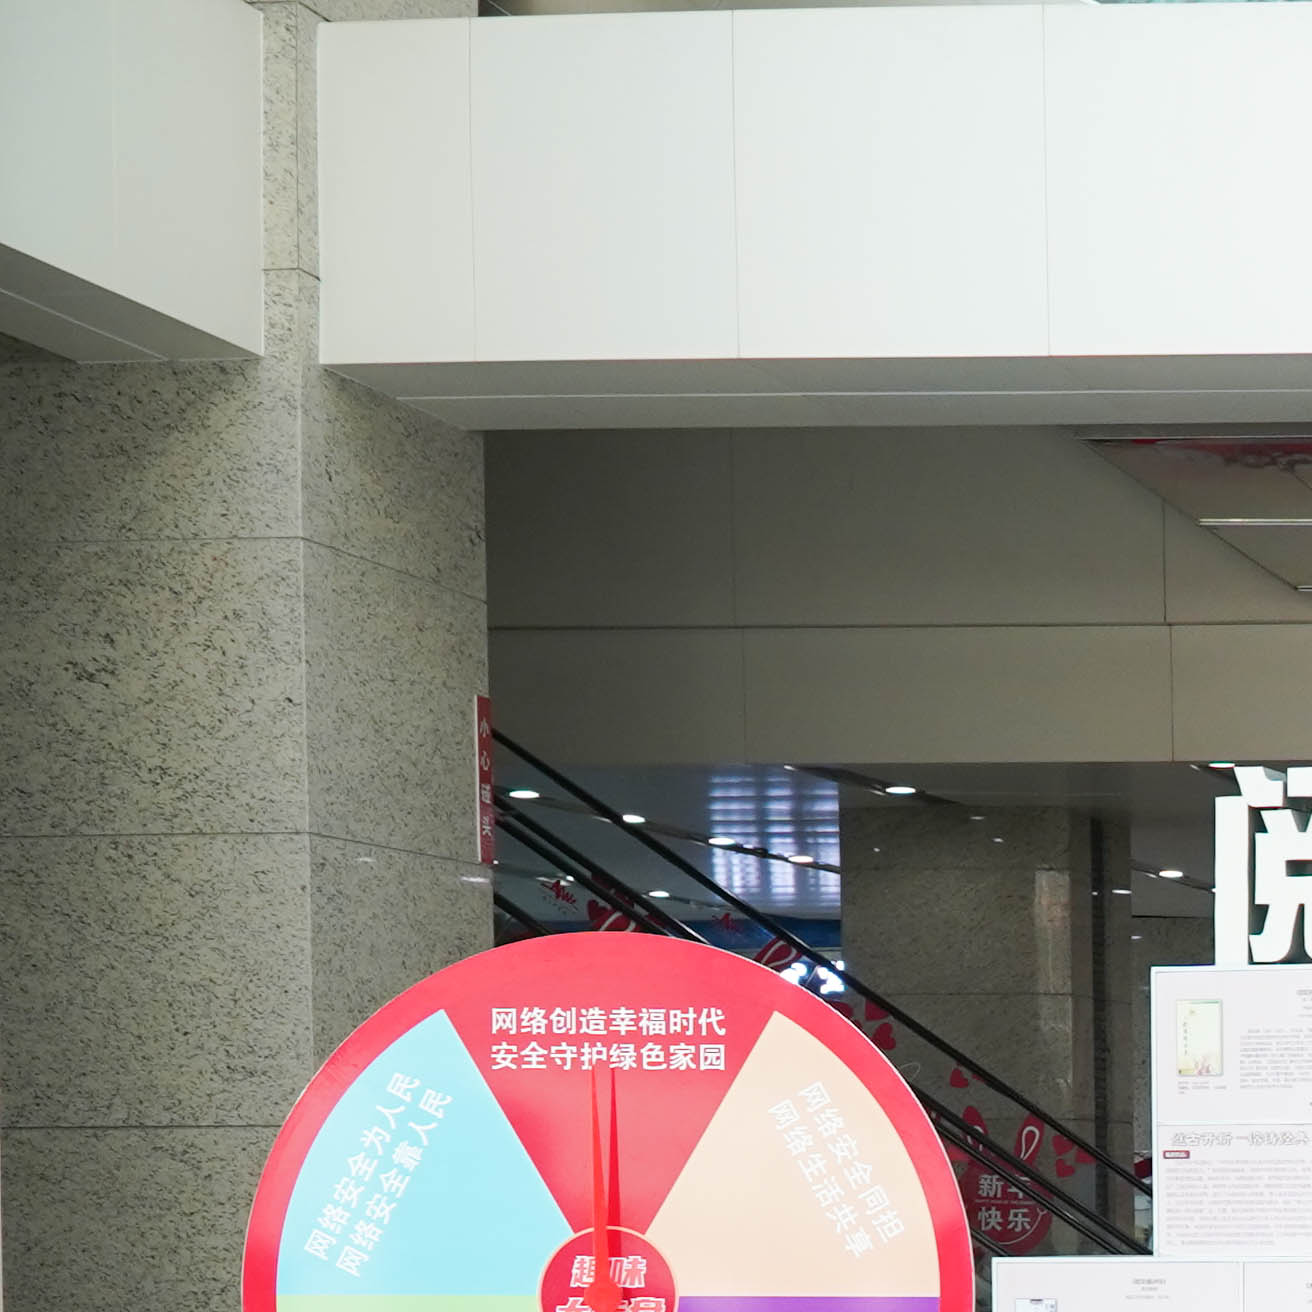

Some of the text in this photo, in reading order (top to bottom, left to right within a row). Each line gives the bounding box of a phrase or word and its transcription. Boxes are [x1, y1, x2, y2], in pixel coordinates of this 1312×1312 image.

[490, 1006, 727, 1037] 网络创造幸福时代
[490, 1042, 727, 1073] 安全守护绿色家园
[303, 1071, 422, 1261] 网络安全为人民
[335, 1090, 454, 1277] 网络安全靠人民
[766, 1101, 874, 1258] 网络生活共享
[797, 1080, 907, 1241] 网络安全同担
[978, 1206, 1032, 1232] 快乐
